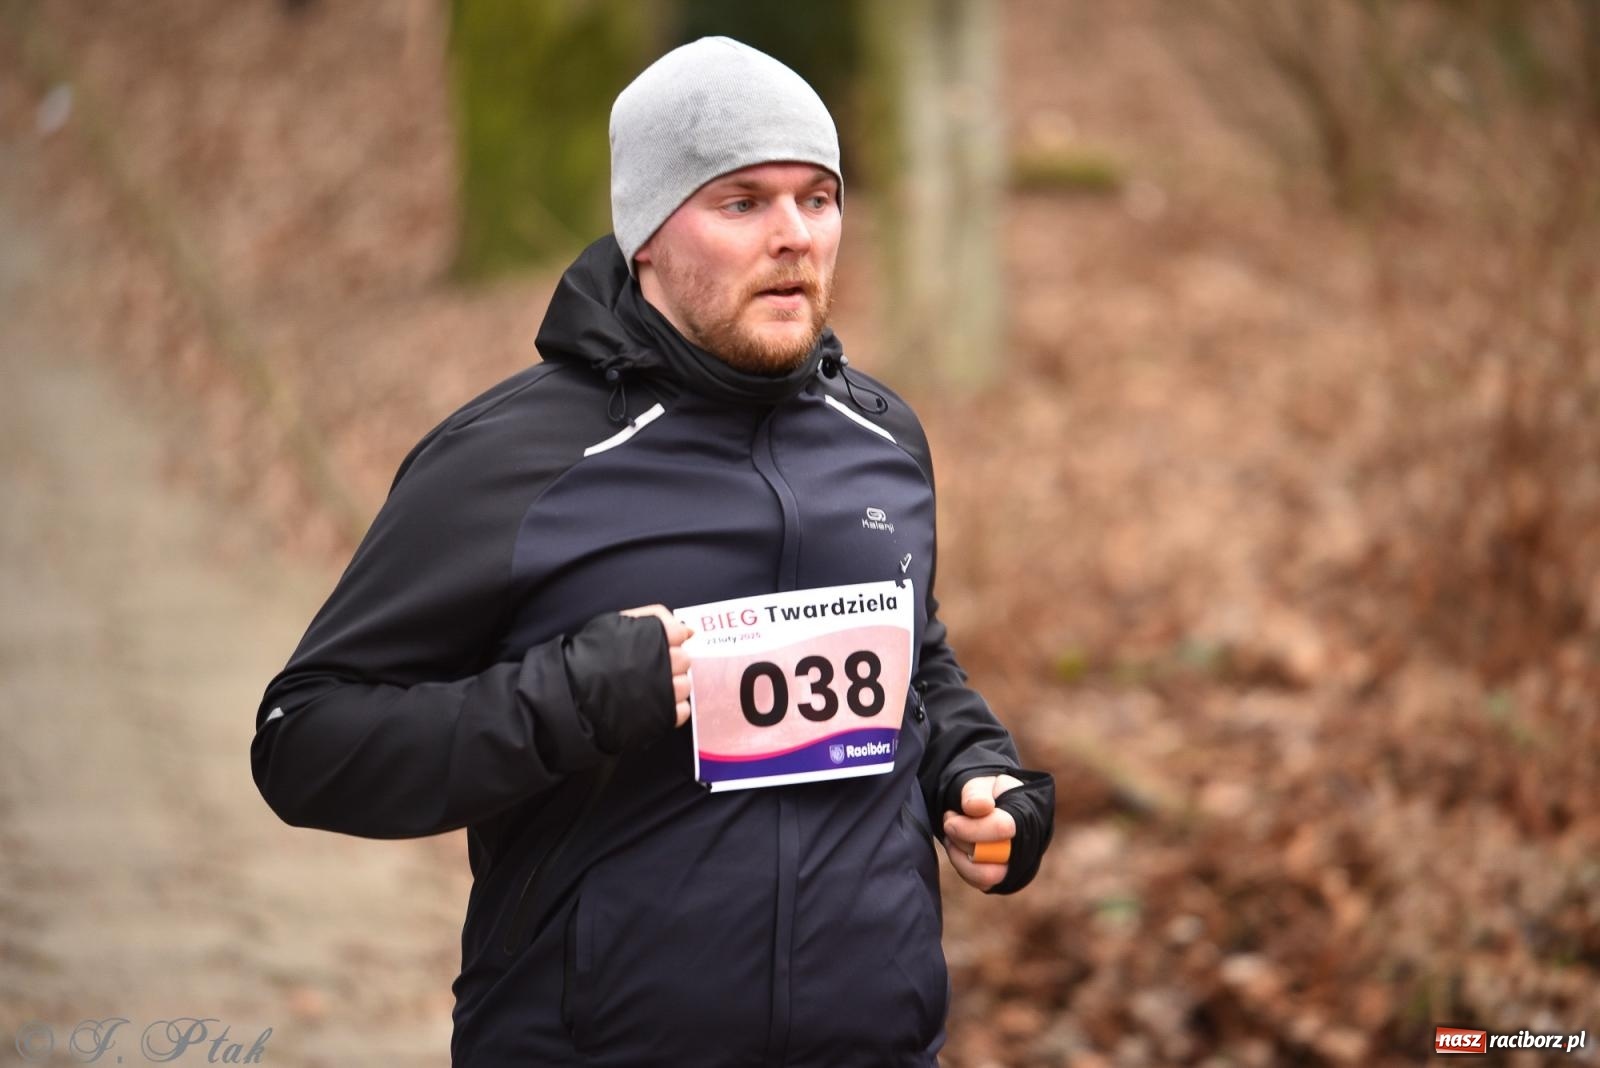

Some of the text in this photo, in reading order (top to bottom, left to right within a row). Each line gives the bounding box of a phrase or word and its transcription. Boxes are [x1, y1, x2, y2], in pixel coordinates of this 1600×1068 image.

[700, 593, 898, 632] BIEG Twardziela
[739, 650, 886, 728] 038
[846, 741, 891, 758] Racibórz
